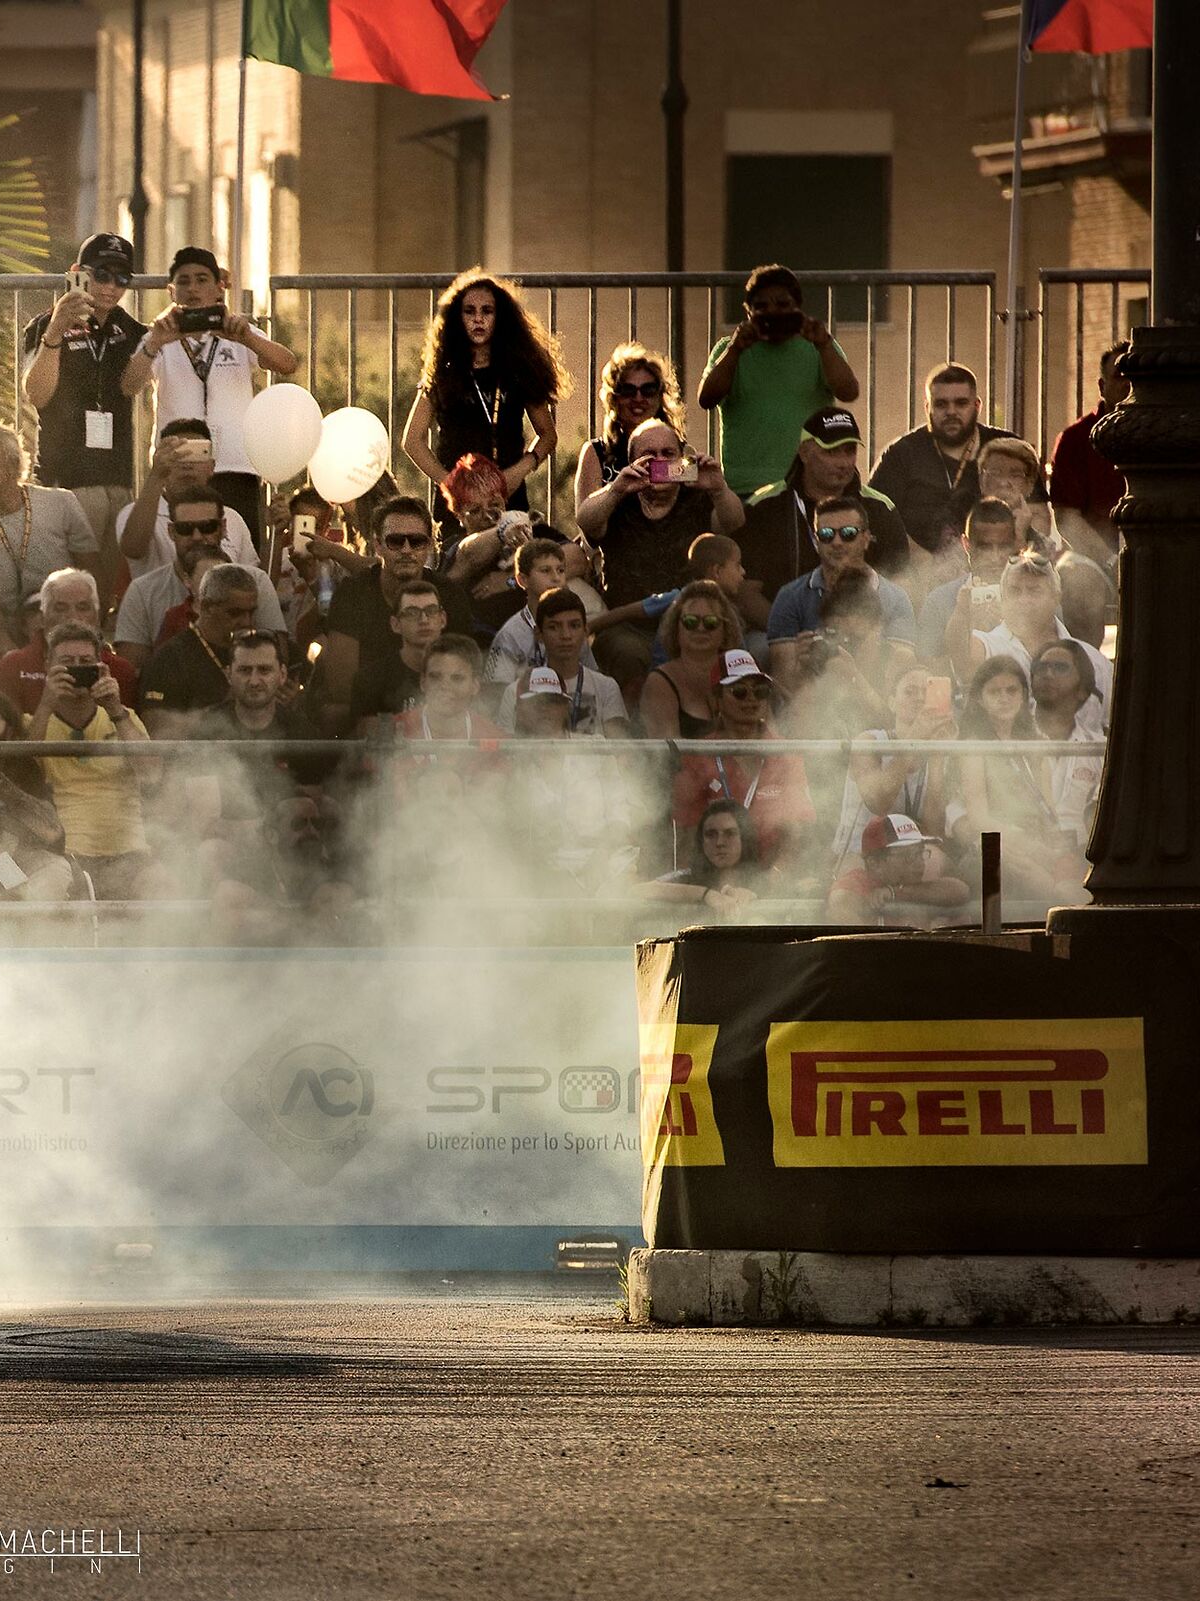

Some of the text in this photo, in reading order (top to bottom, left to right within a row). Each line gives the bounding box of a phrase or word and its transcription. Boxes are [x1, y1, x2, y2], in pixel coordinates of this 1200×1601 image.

[279, 1067, 376, 1118] ACI
[791, 1048, 1110, 1137] PIRELLI
[426, 1132, 506, 1150] Direzione
[512, 1136, 539, 1154] per
[545, 1132, 558, 1150] lo
[564, 1132, 609, 1154] Sport
